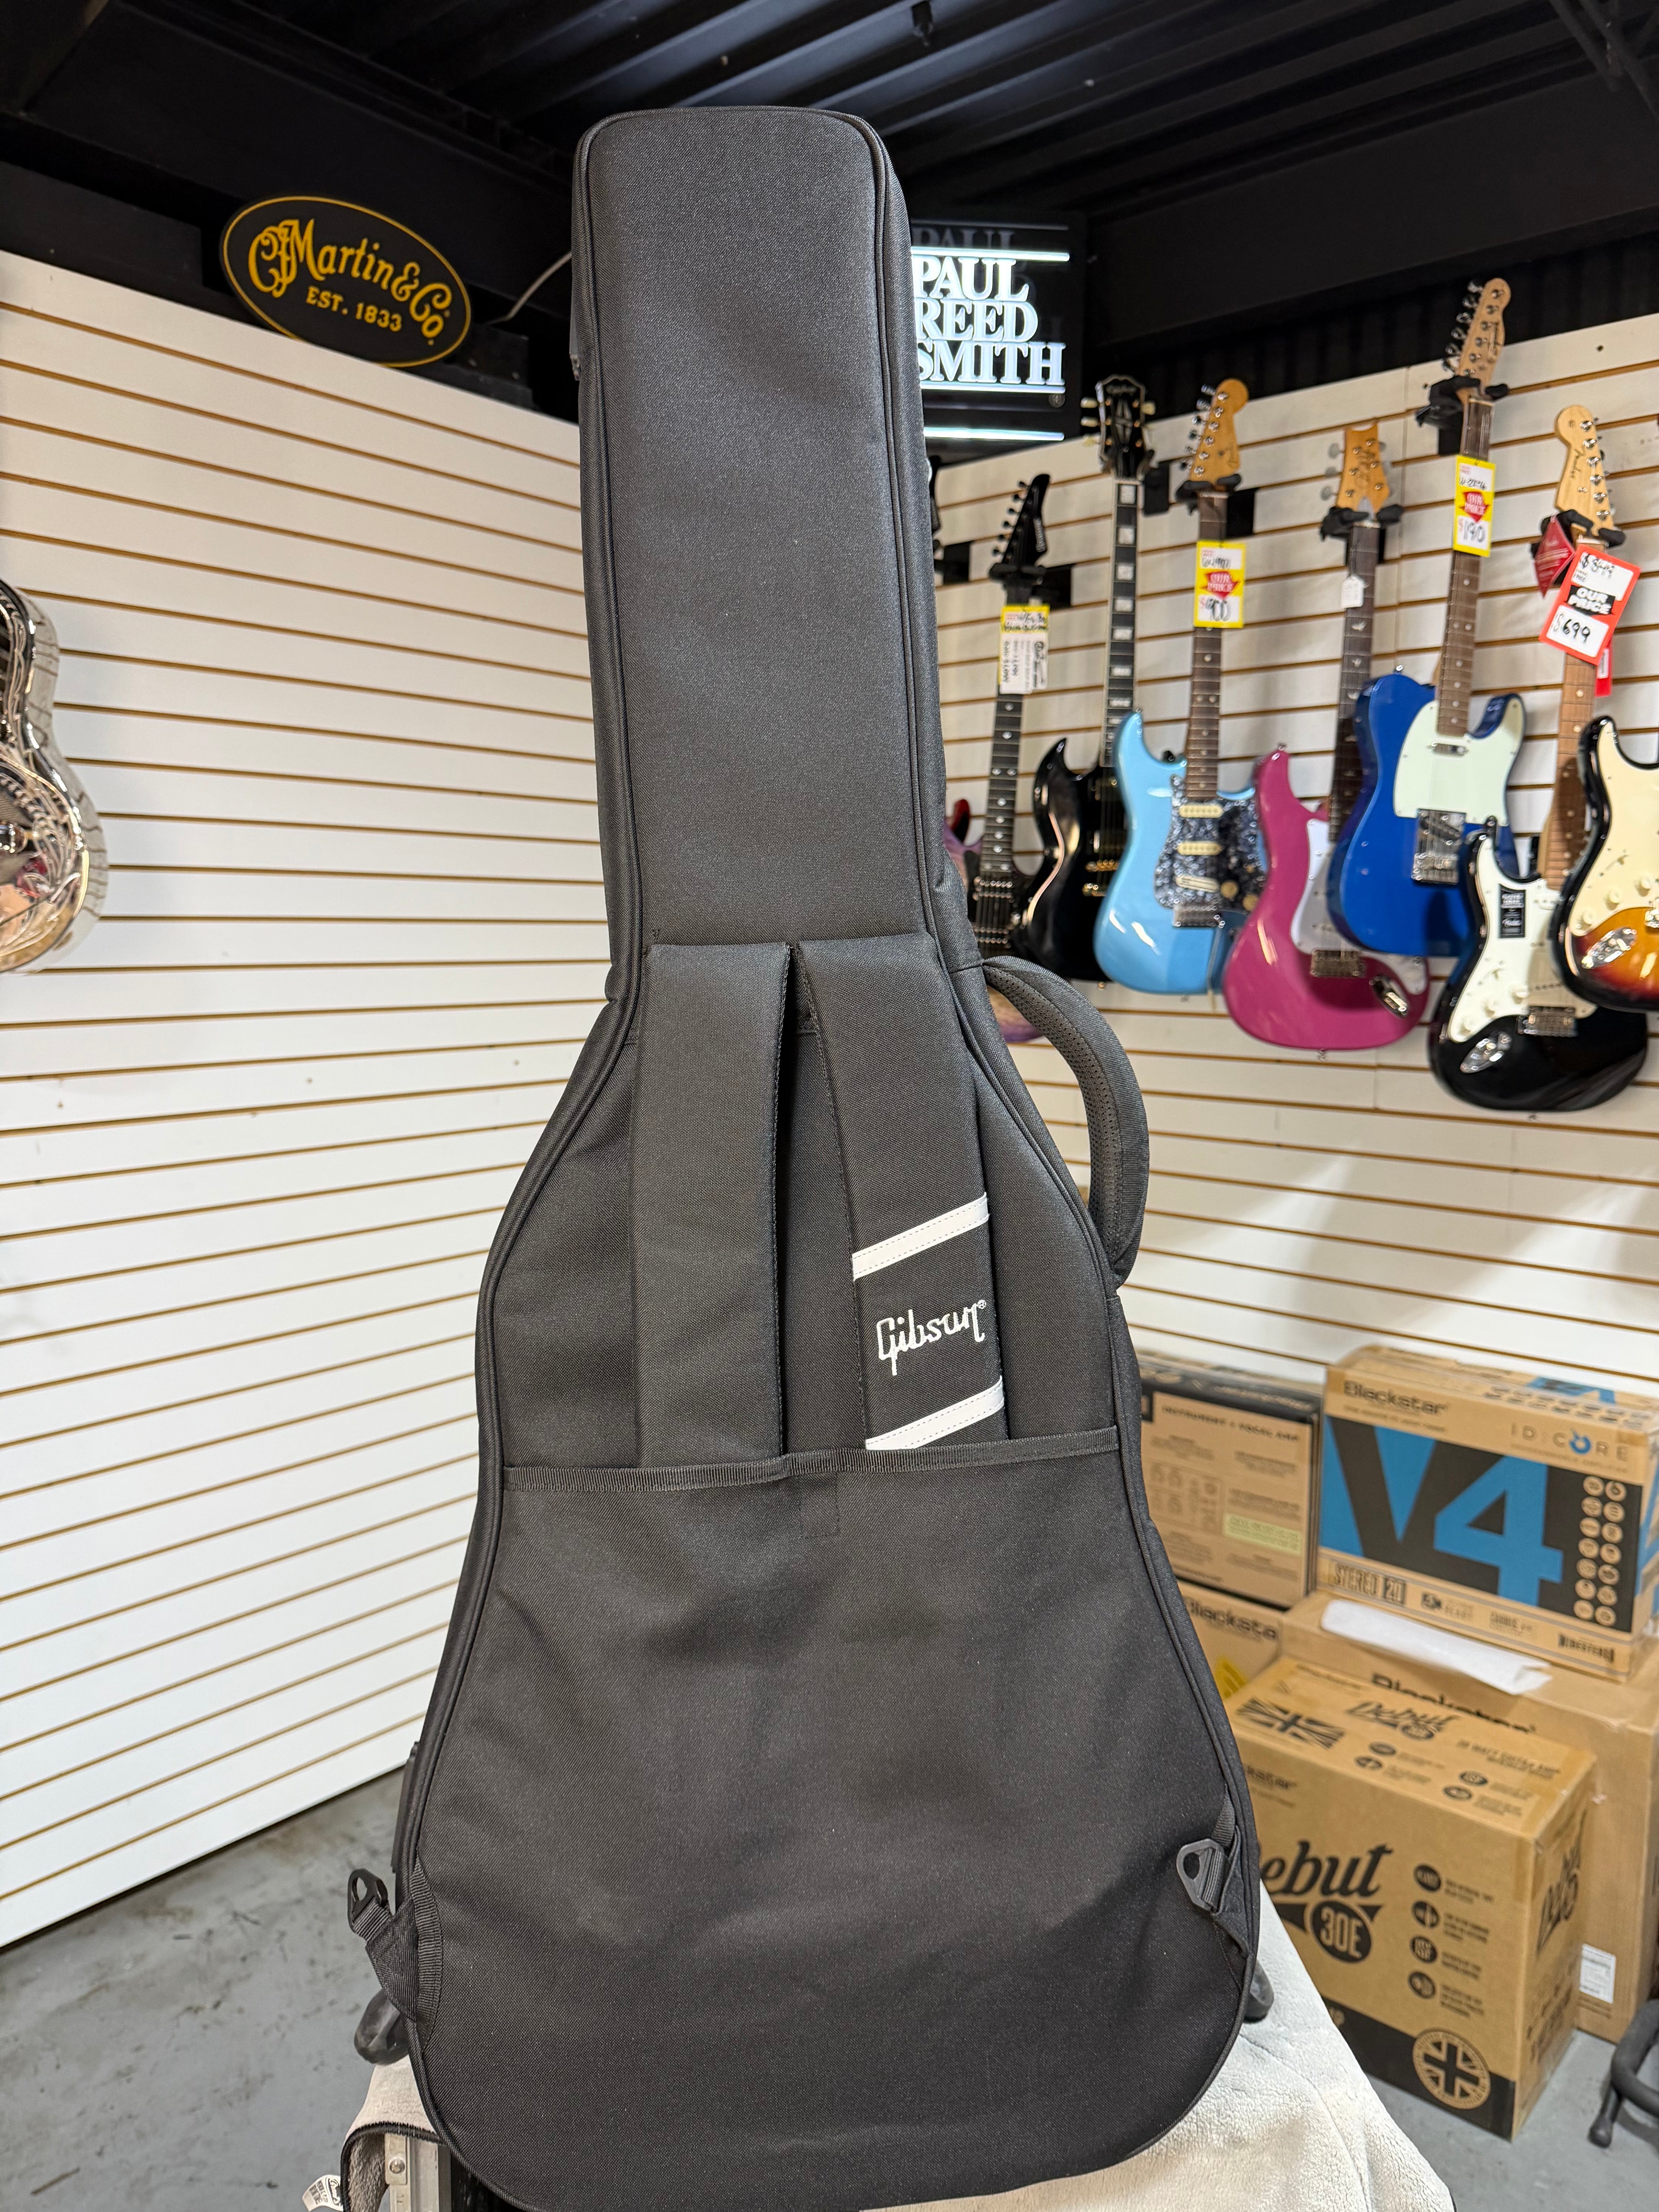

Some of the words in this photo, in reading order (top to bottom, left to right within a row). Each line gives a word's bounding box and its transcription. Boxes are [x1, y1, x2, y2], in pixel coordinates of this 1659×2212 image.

[911, 255, 1029, 302] PAUL
[305, 286, 348, 315] EST.
[355, 302, 402, 332] 1833
[914, 297, 1039, 343] REED
[917, 338, 1066, 386] SMITH
[1568, 594, 1612, 615] PRICE
[1576, 587, 1608, 604] OUR
[1260, 1839, 1393, 1897] ebut
[1320, 1905, 1363, 1960] 30E
